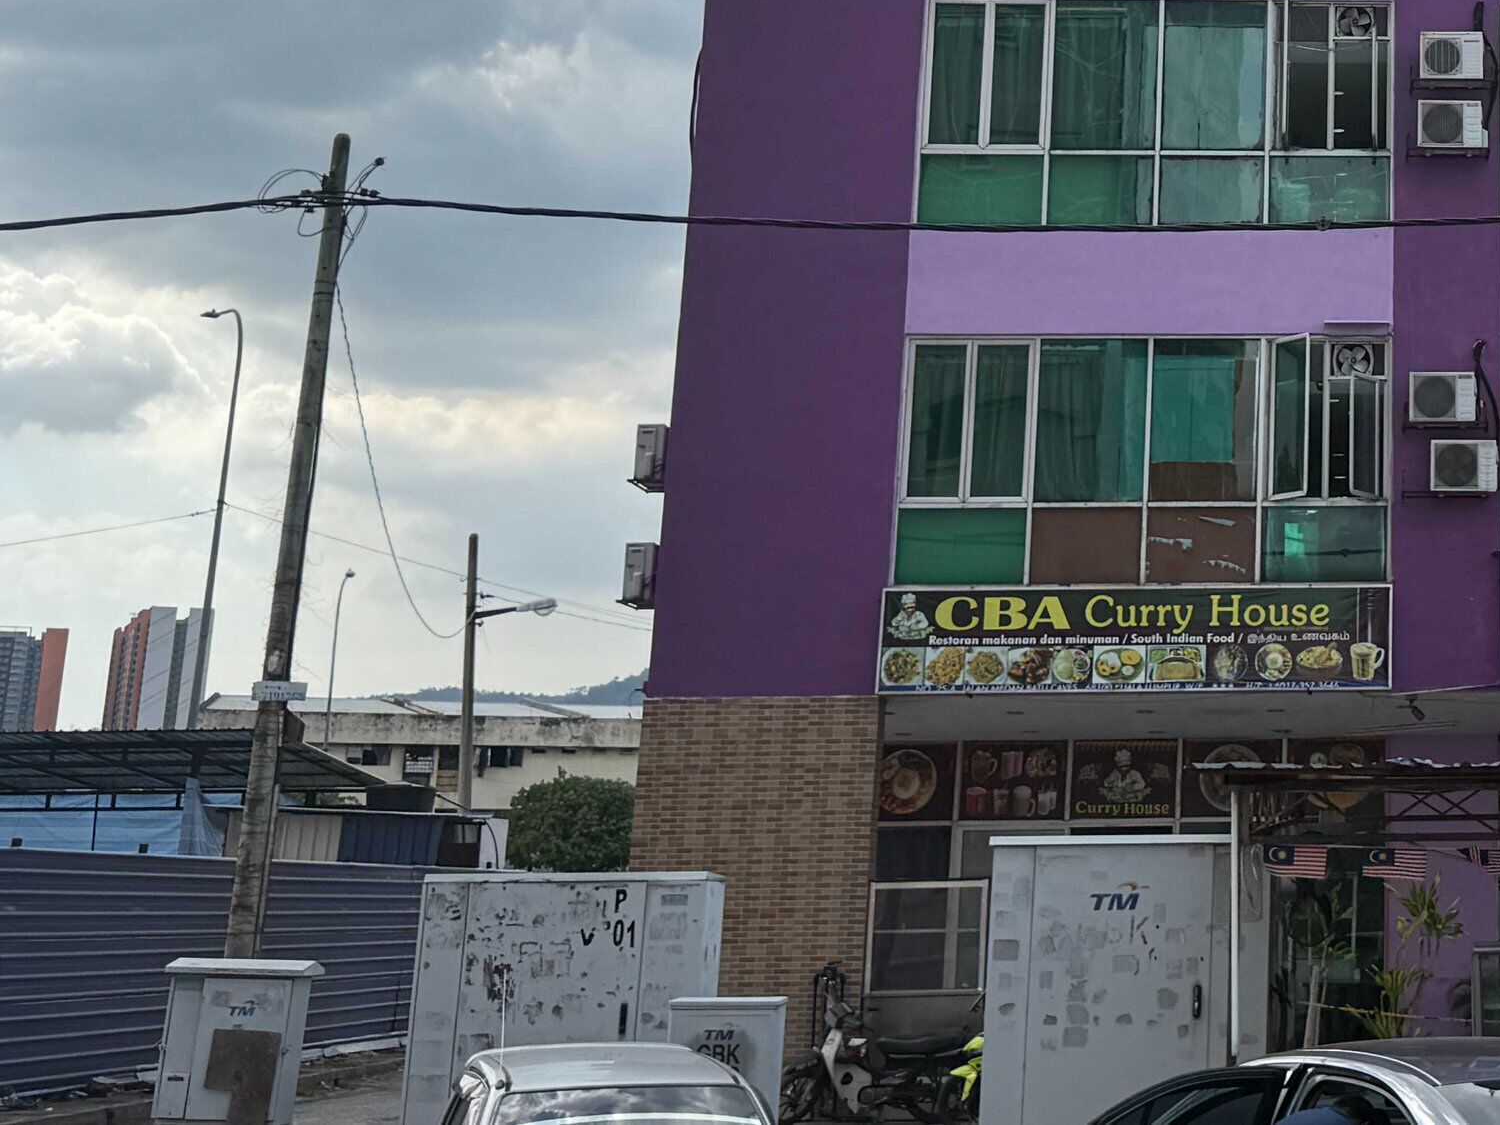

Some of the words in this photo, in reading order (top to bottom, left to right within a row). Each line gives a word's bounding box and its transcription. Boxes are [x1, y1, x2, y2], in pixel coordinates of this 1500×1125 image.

[934, 595, 1071, 632] CBA
[1085, 594, 1193, 634] Curry
[1209, 594, 1330, 627] House
[928, 634, 979, 646] Restoran
[982, 634, 1037, 645] makanan
[1040, 634, 1062, 645] dan
[1065, 634, 1120, 645] minuman
[1130, 632, 1163, 644] South
[1166, 632, 1204, 643] Indian
[1206, 632, 1235, 643] Food
[1075, 800, 1121, 816] Curry
[1089, 892, 1140, 911] TM
[227, 1005, 256, 1017] TM
[703, 1029, 736, 1041] TM
